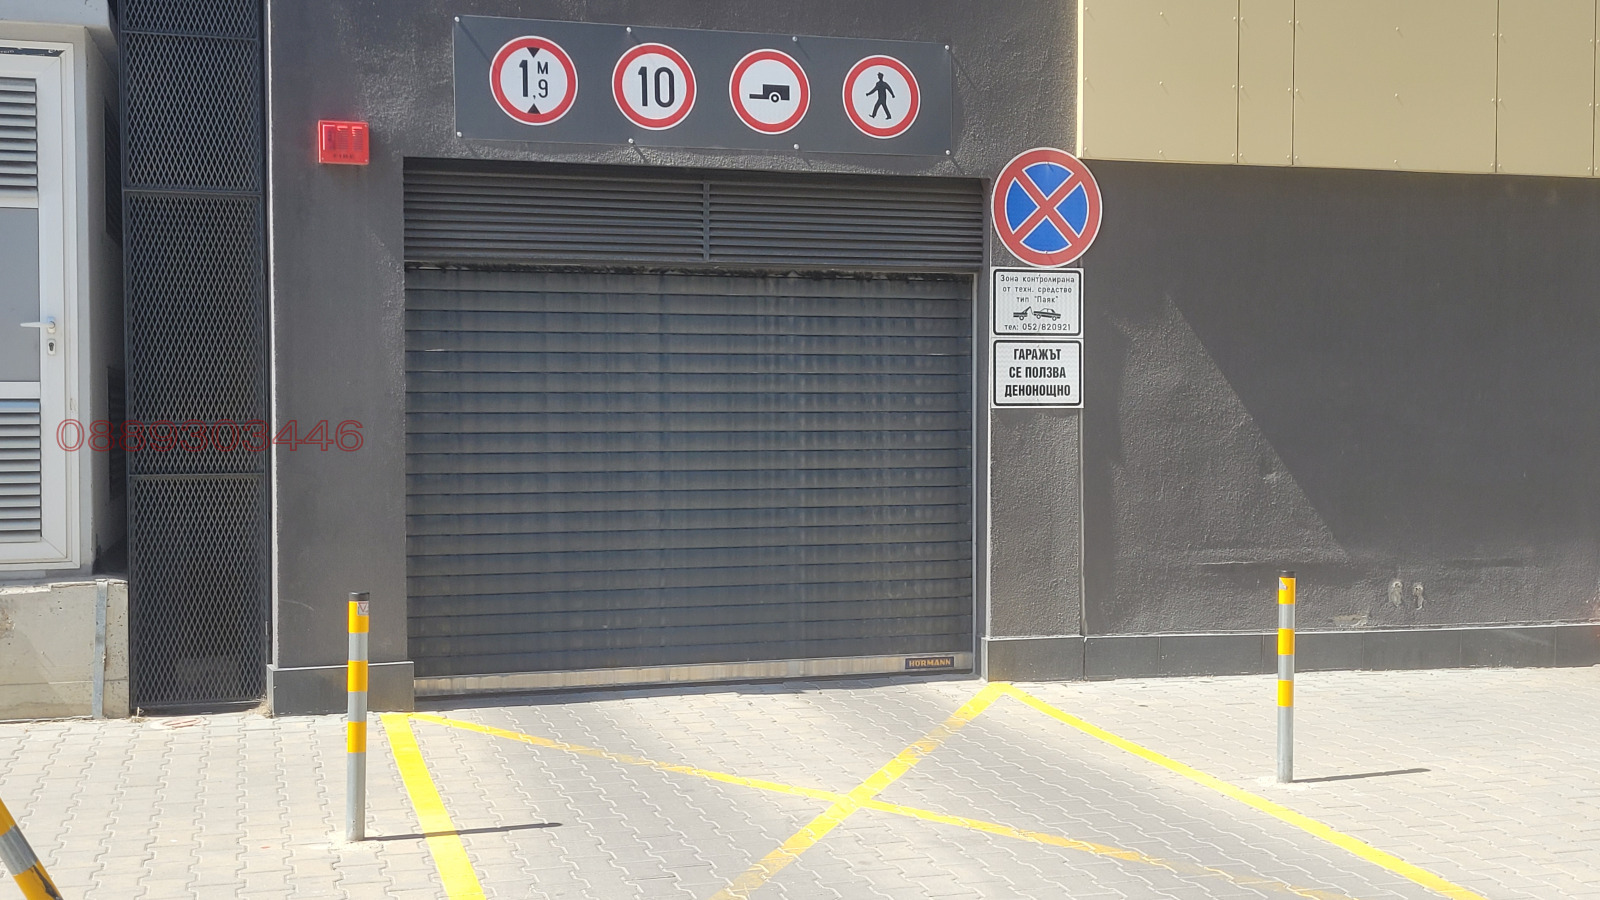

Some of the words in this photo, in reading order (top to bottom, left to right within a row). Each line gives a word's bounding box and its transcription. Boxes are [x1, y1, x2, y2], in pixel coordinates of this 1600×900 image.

[638, 66, 675, 108] 10
[1000, 274, 1019, 282] Зона
[1022, 275, 1075, 285] контролирана
[1037, 287, 1072, 295] средство
[1034, 295, 1059, 304] "Паяк"
[1004, 323, 1019, 331] тел:
[1022, 323, 1071, 332] 052/820921
[1013, 348, 1062, 361] ГАРАЖЪТ
[1008, 366, 1022, 379] СЕ
[1025, 366, 1067, 379] ПОЛЗВА
[1004, 384, 1071, 398] ДЕНОНОЩНО
